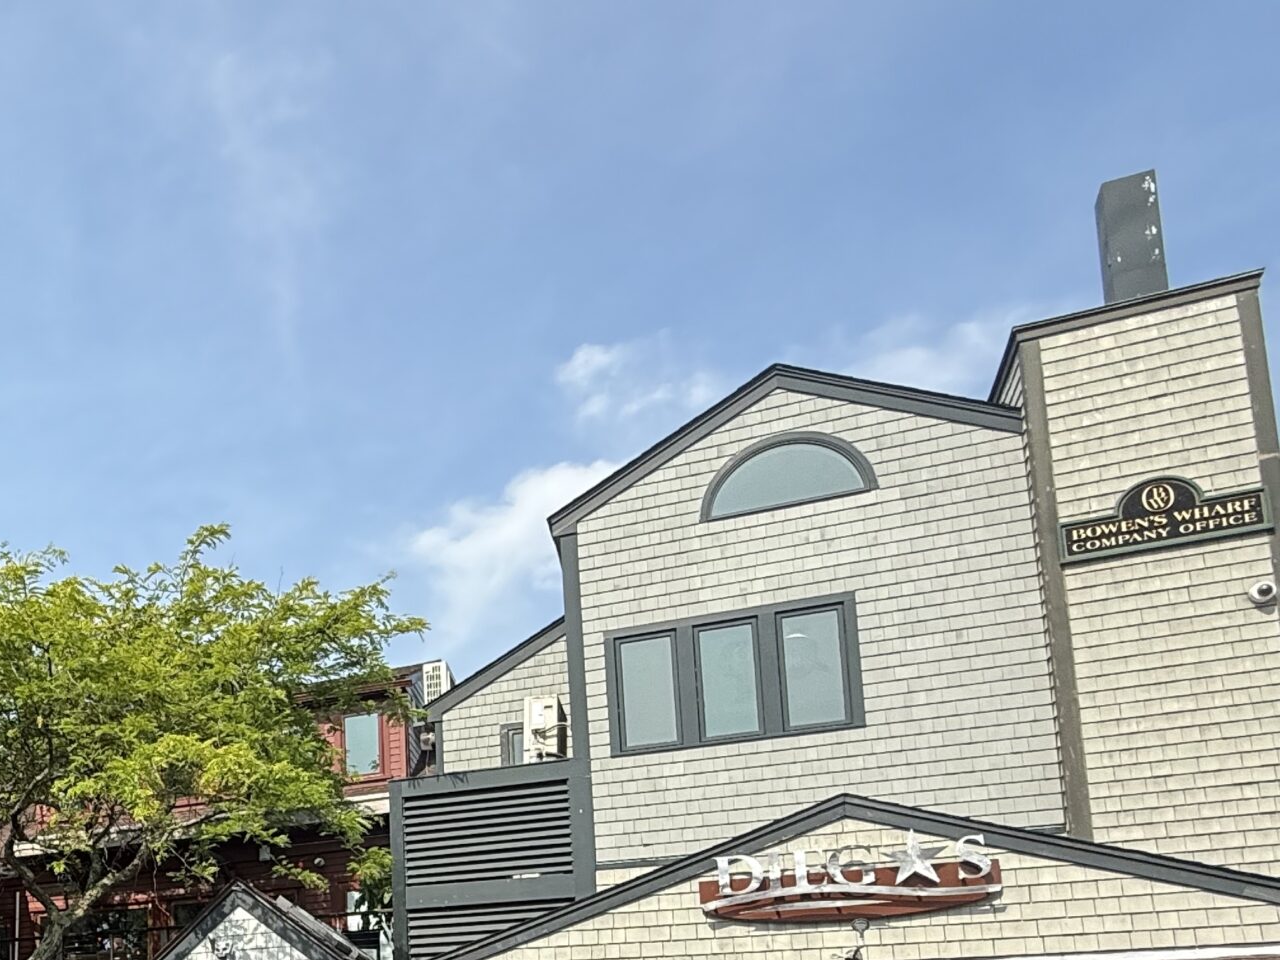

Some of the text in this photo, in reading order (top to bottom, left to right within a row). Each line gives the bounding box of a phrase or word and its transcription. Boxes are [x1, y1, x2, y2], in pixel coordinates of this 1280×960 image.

[1071, 512, 1258, 552] COMPANY OFFICE
[1072, 497, 1257, 541] BOWEN'S WHARF
